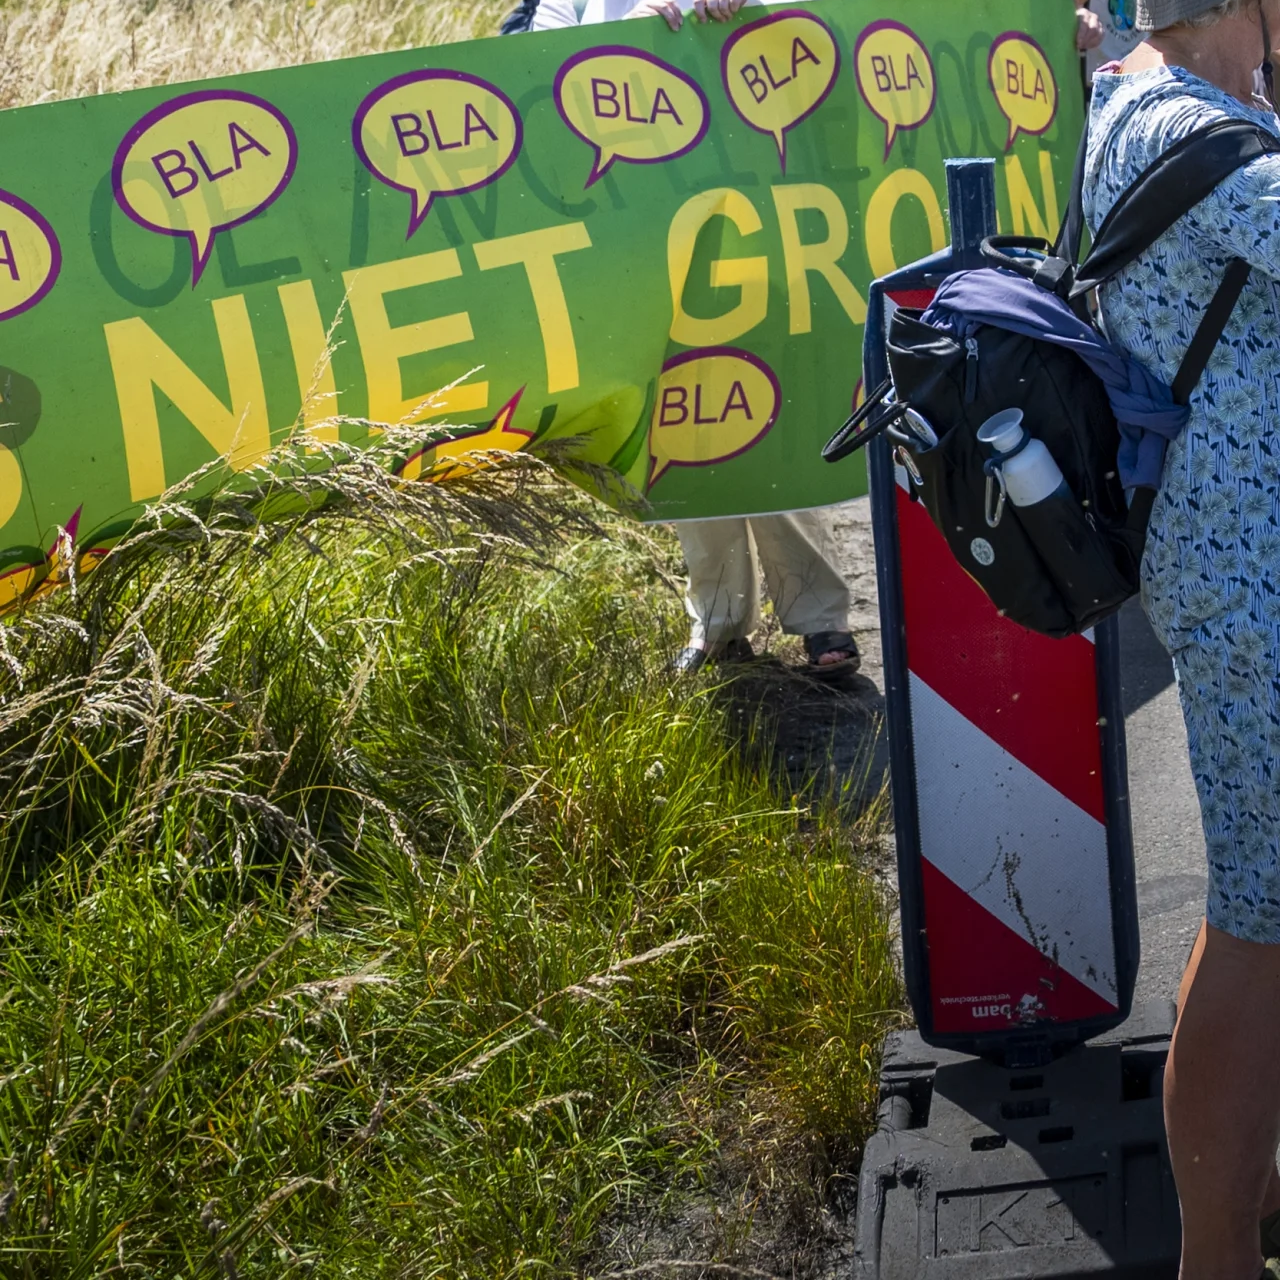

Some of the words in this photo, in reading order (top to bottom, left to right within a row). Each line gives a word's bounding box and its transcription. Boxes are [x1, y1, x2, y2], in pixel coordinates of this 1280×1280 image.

[740, 36, 821, 104] BLA
[875, 54, 925, 94] BLA
[1006, 59, 1048, 104] BLA
[592, 79, 684, 126] BLA
[391, 102, 499, 158] BLA
[152, 120, 271, 200] BLA
[103, 221, 593, 503] NIET
[667, 150, 1060, 347] GRON
[659, 380, 753, 428] BLA
[939, 993, 1011, 1005] verkeerstechniek
[971, 1003, 1012, 1020] bam
